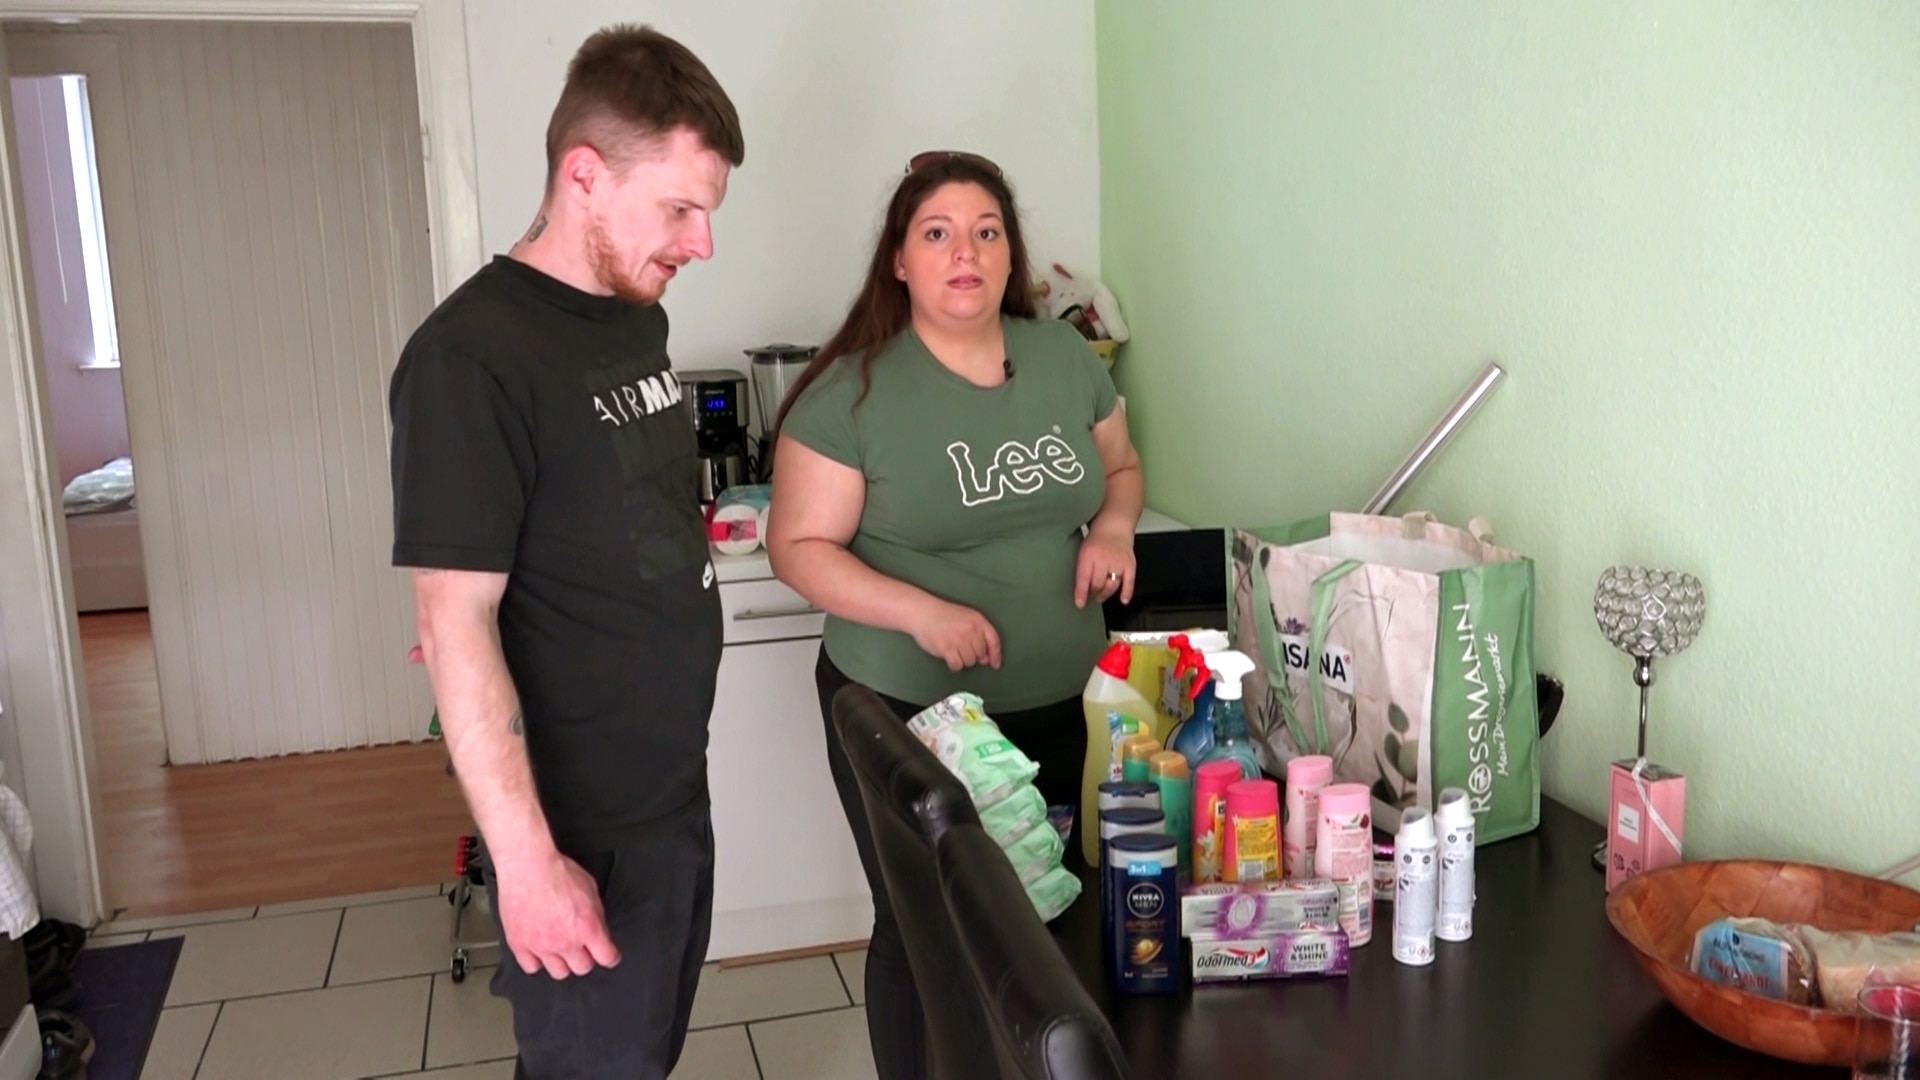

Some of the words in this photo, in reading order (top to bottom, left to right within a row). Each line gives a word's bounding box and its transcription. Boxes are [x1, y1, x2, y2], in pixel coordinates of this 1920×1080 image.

[947, 435, 1084, 506] Lee
[1452, 603, 1492, 814] ROSSMANN
[1132, 893, 1160, 901] NIVEA
[1292, 943, 1326, 952] WHITE
[1298, 952, 1328, 961] SHINE
